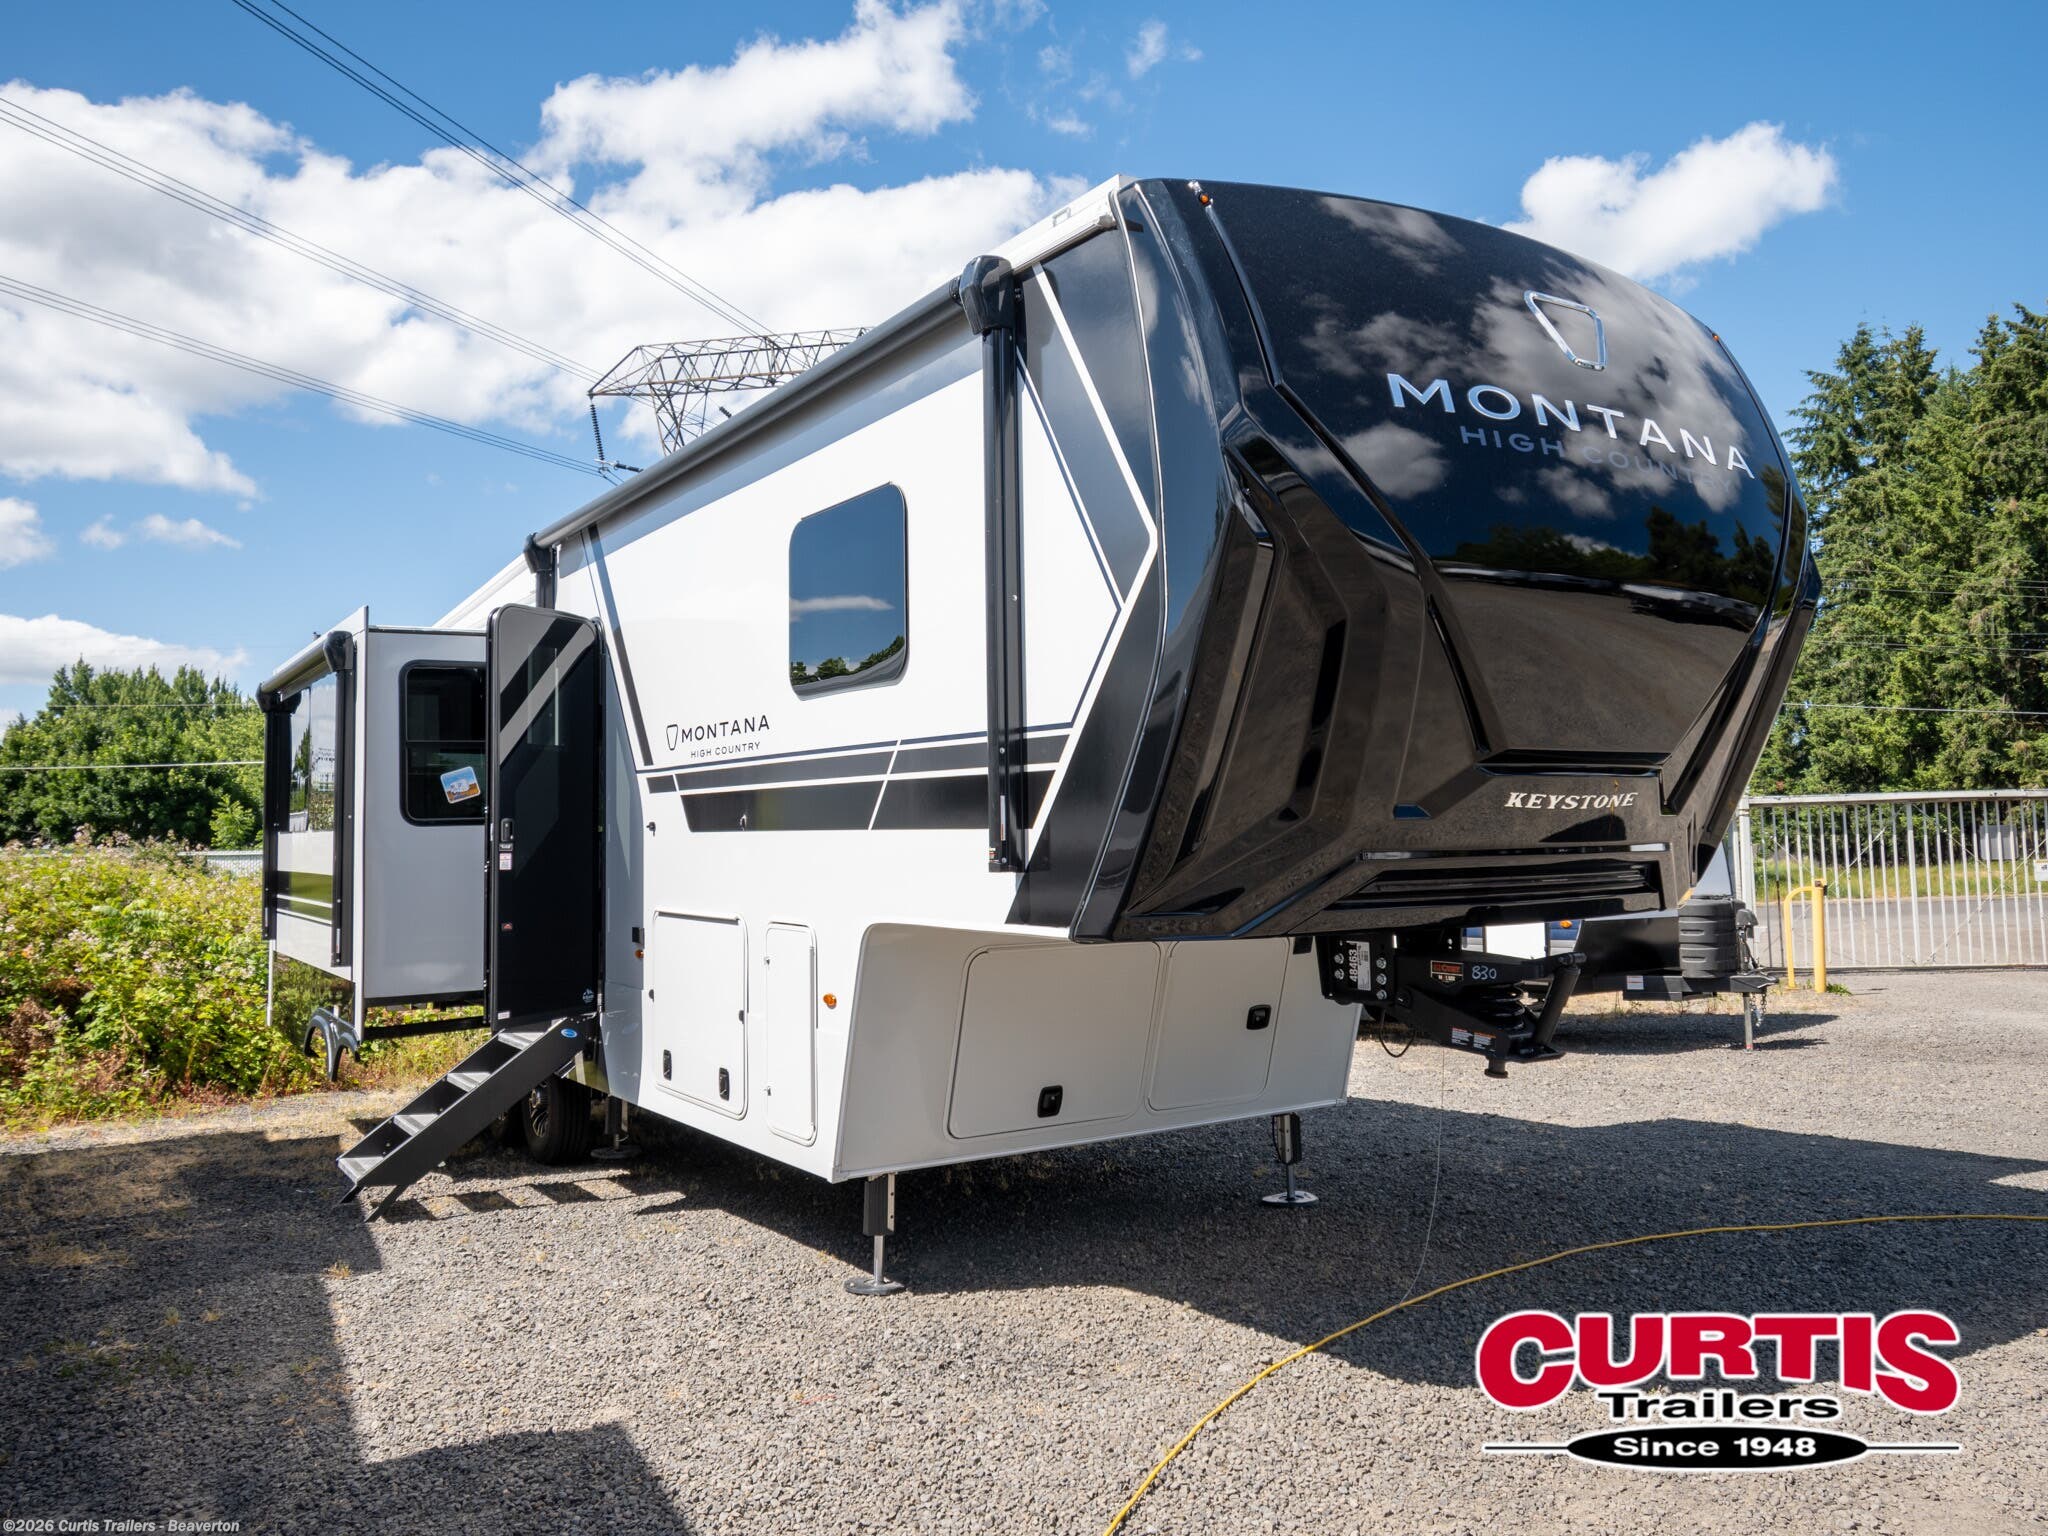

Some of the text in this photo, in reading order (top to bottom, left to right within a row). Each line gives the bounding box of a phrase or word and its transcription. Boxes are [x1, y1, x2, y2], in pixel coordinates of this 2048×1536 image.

[1386, 373, 1755, 479] MONTANA
[1460, 425, 1731, 493] HIGH COUNTRY
[681, 715, 770, 742] MONTANA
[690, 741, 761, 758] HIGH COUNTRY
[1504, 792, 1639, 809] KEYSTONE
[1472, 965, 1497, 980] 830
